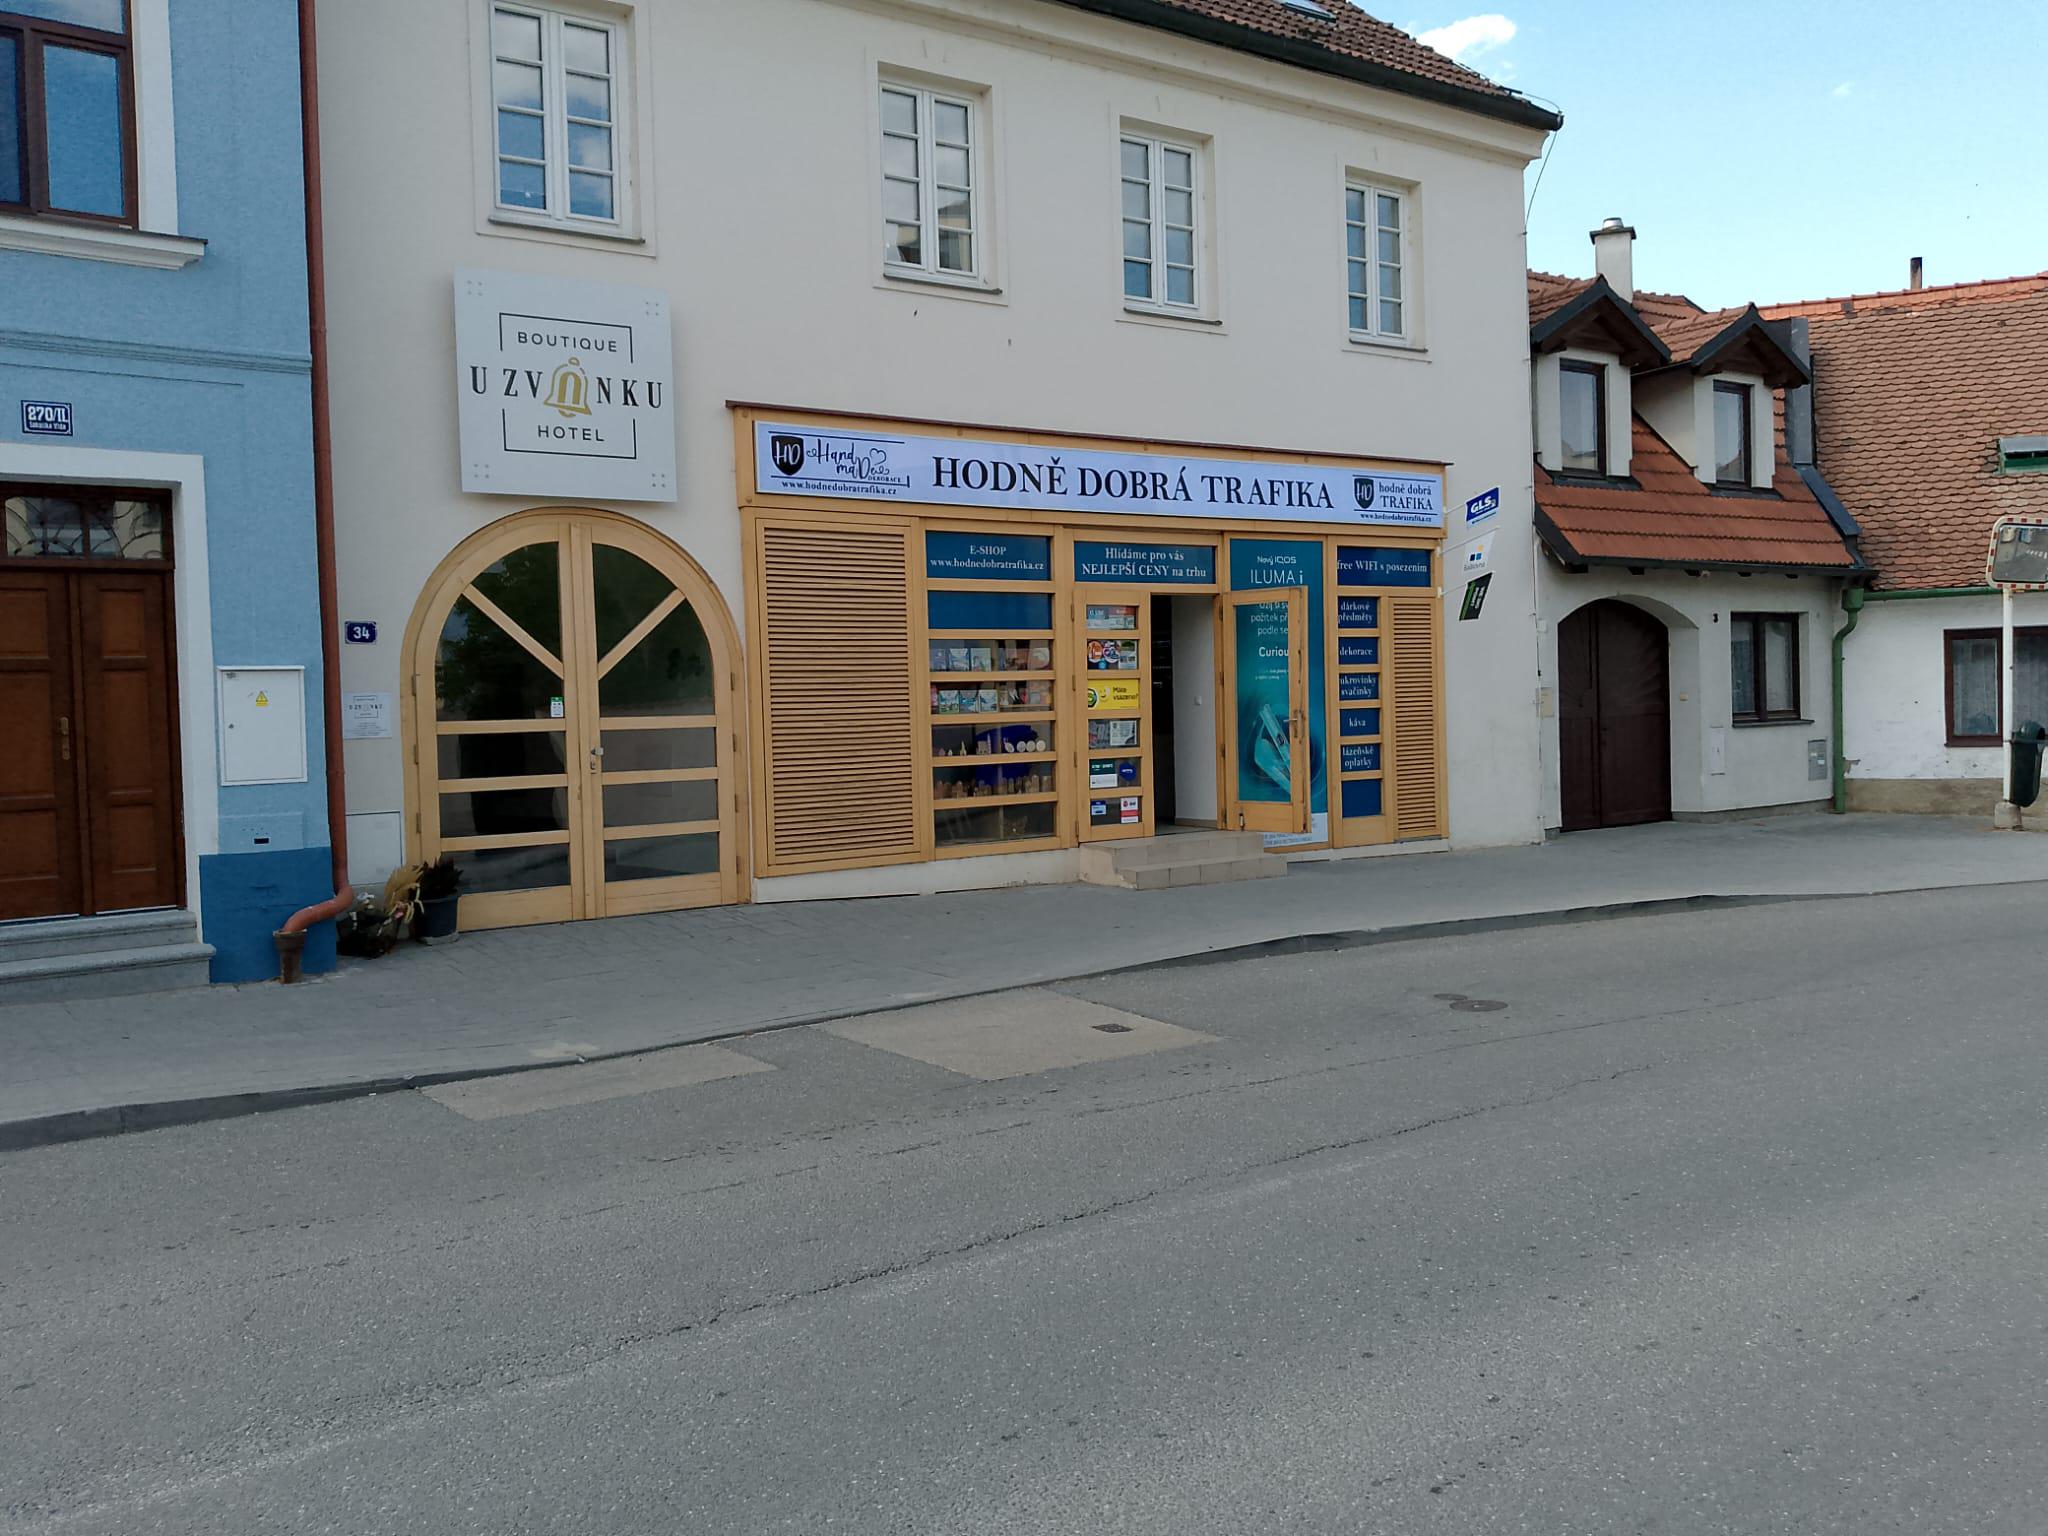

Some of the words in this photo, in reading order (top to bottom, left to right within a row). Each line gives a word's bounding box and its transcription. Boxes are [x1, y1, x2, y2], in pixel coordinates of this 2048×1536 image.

[517, 331, 618, 353] BOUTIQUE
[537, 425, 605, 442] HOTEL
[782, 480, 897, 495] www.hodnedobratrafika.cz
[932, 456, 1068, 496] HODNĚ
[1077, 466, 1193, 502] DOBRÁ
[1200, 475, 1335, 509] TRAFIKA
[1379, 482, 1405, 494] hodně
[1407, 483, 1432, 496] dobrá
[1380, 494, 1433, 510] TRAFIKA
[1470, 495, 1492, 514] GLS
[970, 545, 1007, 556] E-SHOP
[1105, 547, 1147, 560] Hlídáme
[1150, 551, 1166, 563] pro
[1169, 550, 1184, 561] vás
[930, 557, 1044, 570] www.hodnedobratrafika.cz
[1275, 556, 1297, 565] IQOS
[1337, 560, 1353, 571] free
[1355, 560, 1378, 572] WIFI
[1082, 561, 1136, 576] NEJLEPŠÍ
[1138, 564, 1170, 576] CENY
[1172, 568, 1184, 577] na
[1186, 565, 1206, 578] trhu
[1250, 569, 1296, 585] ILUMA
[1341, 601, 1370, 611] dárkové
[353, 626, 370, 639] 34
[1340, 646, 1373, 656] dekorace
[1349, 717, 1366, 728] káva
[1344, 757, 1372, 769] oplatky
